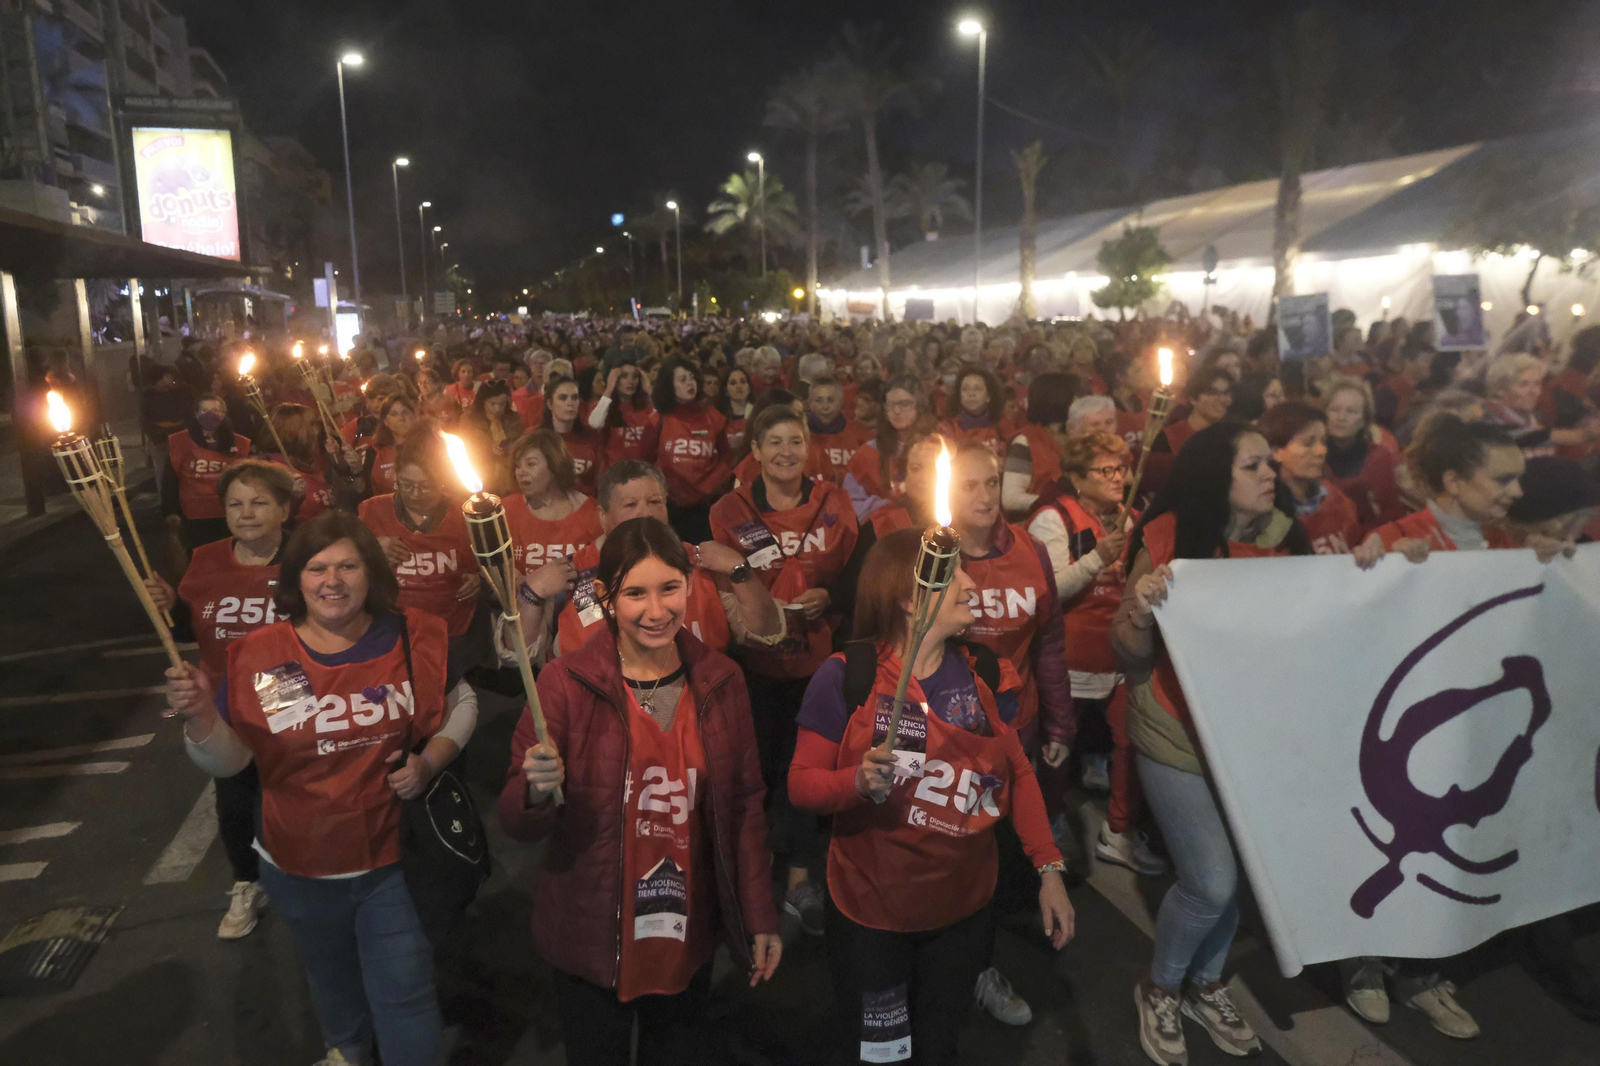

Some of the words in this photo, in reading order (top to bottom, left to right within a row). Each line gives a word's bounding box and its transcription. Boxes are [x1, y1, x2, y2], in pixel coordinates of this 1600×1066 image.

[148, 190, 232, 219] donuts
[876, 715, 886, 723] LA
[875, 723, 891, 731] TIEN
[650, 879, 686, 892] VIOLENCIA
[638, 890, 657, 898] TIENE
[658, 886, 687, 900] GÉNERO
[875, 1006, 908, 1020] VIOLENCIA
[863, 1019, 882, 1027] TIENE
